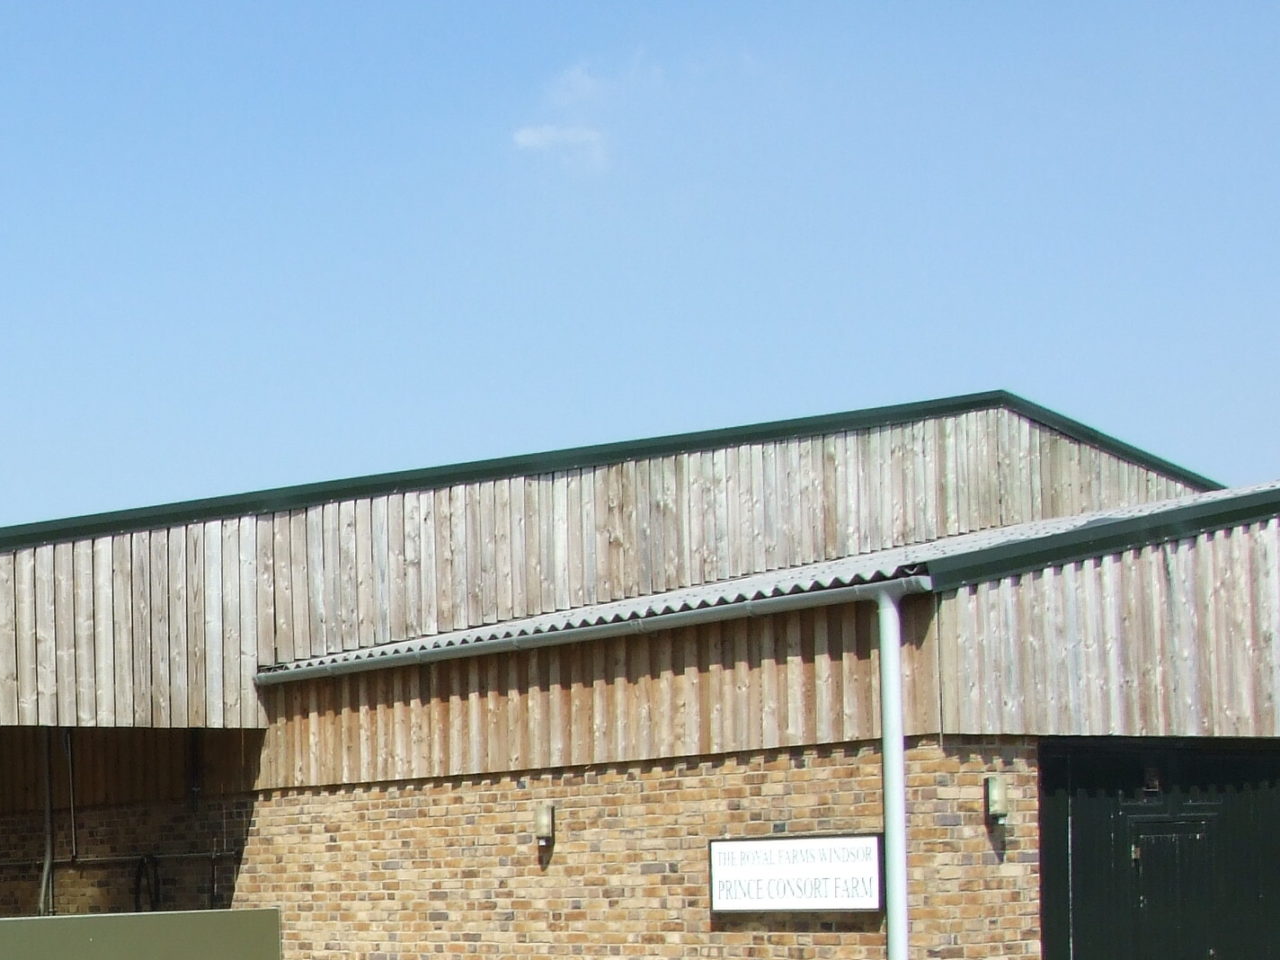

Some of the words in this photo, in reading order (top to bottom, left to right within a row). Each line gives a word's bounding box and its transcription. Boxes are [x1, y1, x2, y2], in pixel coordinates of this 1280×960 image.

[718, 851, 737, 867] THE
[740, 850, 775, 866] ROYAL
[778, 848, 816, 865] FARMS
[818, 846, 873, 862] WINDSOR
[718, 879, 763, 901] PRINCE
[767, 877, 830, 900] CONSORT
[834, 876, 873, 898] FARM
